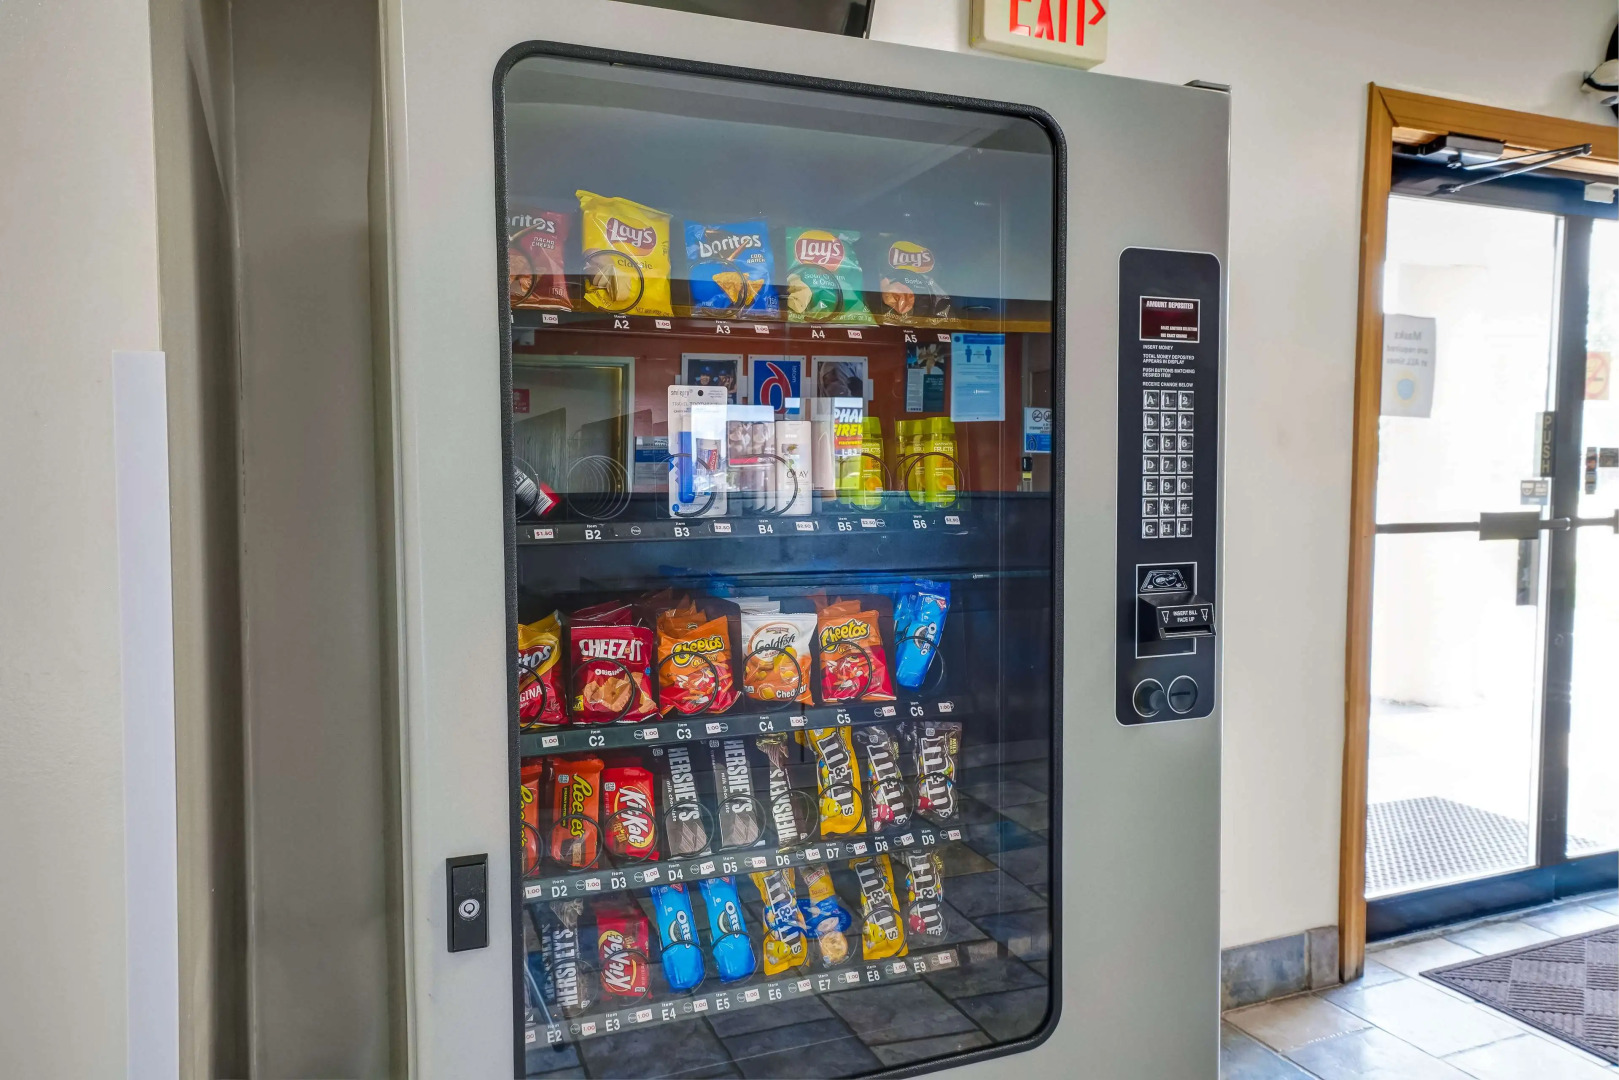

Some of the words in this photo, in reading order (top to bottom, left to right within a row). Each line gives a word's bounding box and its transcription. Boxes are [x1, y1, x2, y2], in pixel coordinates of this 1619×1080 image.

[610, 219, 654, 247] Lay's
[698, 235, 762, 258] Doritos
[801, 239, 841, 264] Lay's
[893, 249, 931, 267] Lay's
[617, 259, 654, 270] Claic
[1168, 302, 1194, 310] DEPOSITED
[614, 320, 630, 329] A2
[716, 325, 731, 334] A3
[811, 330, 826, 338] A4
[904, 334, 918, 343] A5
[1147, 397, 1154, 405] A
[1182, 397, 1188, 405] 2
[1147, 417, 1154, 426] B
[1165, 417, 1171, 426] 3
[1181, 417, 1187, 425] 4
[1146, 438, 1154, 448] C
[1165, 439, 1171, 447] 5
[1181, 438, 1187, 447] 6
[1541, 415, 1552, 473] PUSH
[1147, 460, 1154, 469] D
[1165, 460, 1170, 469] 7
[1181, 460, 1187, 469] 8
[787, 471, 808, 479] OAY
[1146, 481, 1153, 491] E
[1164, 481, 1170, 491] 9
[1181, 481, 1187, 490] 0
[1146, 503, 1153, 512] F
[1181, 503, 1187, 511] #
[758, 525, 774, 534] B4
[838, 522, 853, 531] B5
[913, 520, 928, 529] B6
[1145, 524, 1153, 534] G
[1163, 524, 1171, 533] H
[1181, 523, 1187, 533] J
[585, 530, 602, 539] B2
[674, 527, 690, 537] B3
[821, 619, 870, 652] Cheetos
[755, 633, 796, 653] Goldfish
[671, 636, 724, 667] Cheetos
[518, 645, 552, 675] itos
[776, 684, 807, 698] Chedar
[910, 706, 924, 717] C6
[837, 713, 851, 724] C5
[759, 720, 774, 732] C4
[676, 728, 692, 740] C3
[589, 735, 605, 747] C2
[723, 740, 753, 814] HERSHEY'S
[667, 746, 701, 822] HERSHEY'S
[571, 773, 593, 838] Reee's
[769, 768, 799, 844] HERSHEY'S
[922, 834, 935, 845] D9
[875, 841, 889, 852] D8
[826, 848, 840, 859] D7
[776, 855, 790, 866] D6
[723, 861, 738, 873] D5
[645, 870, 658, 878] 1.00
[668, 870, 683, 881] D4
[611, 877, 627, 889] D3
[552, 886, 567, 897] D2
[552, 928, 579, 1007] HERSHEY'S
[913, 961, 927, 972] E9
[866, 970, 880, 981] E8
[818, 979, 831, 990] E7
[768, 989, 782, 1000] E6
[716, 998, 731, 1010] E5
[662, 1008, 676, 1020] E4
[606, 1019, 621, 1031] E3
[547, 1031, 562, 1043] E2
